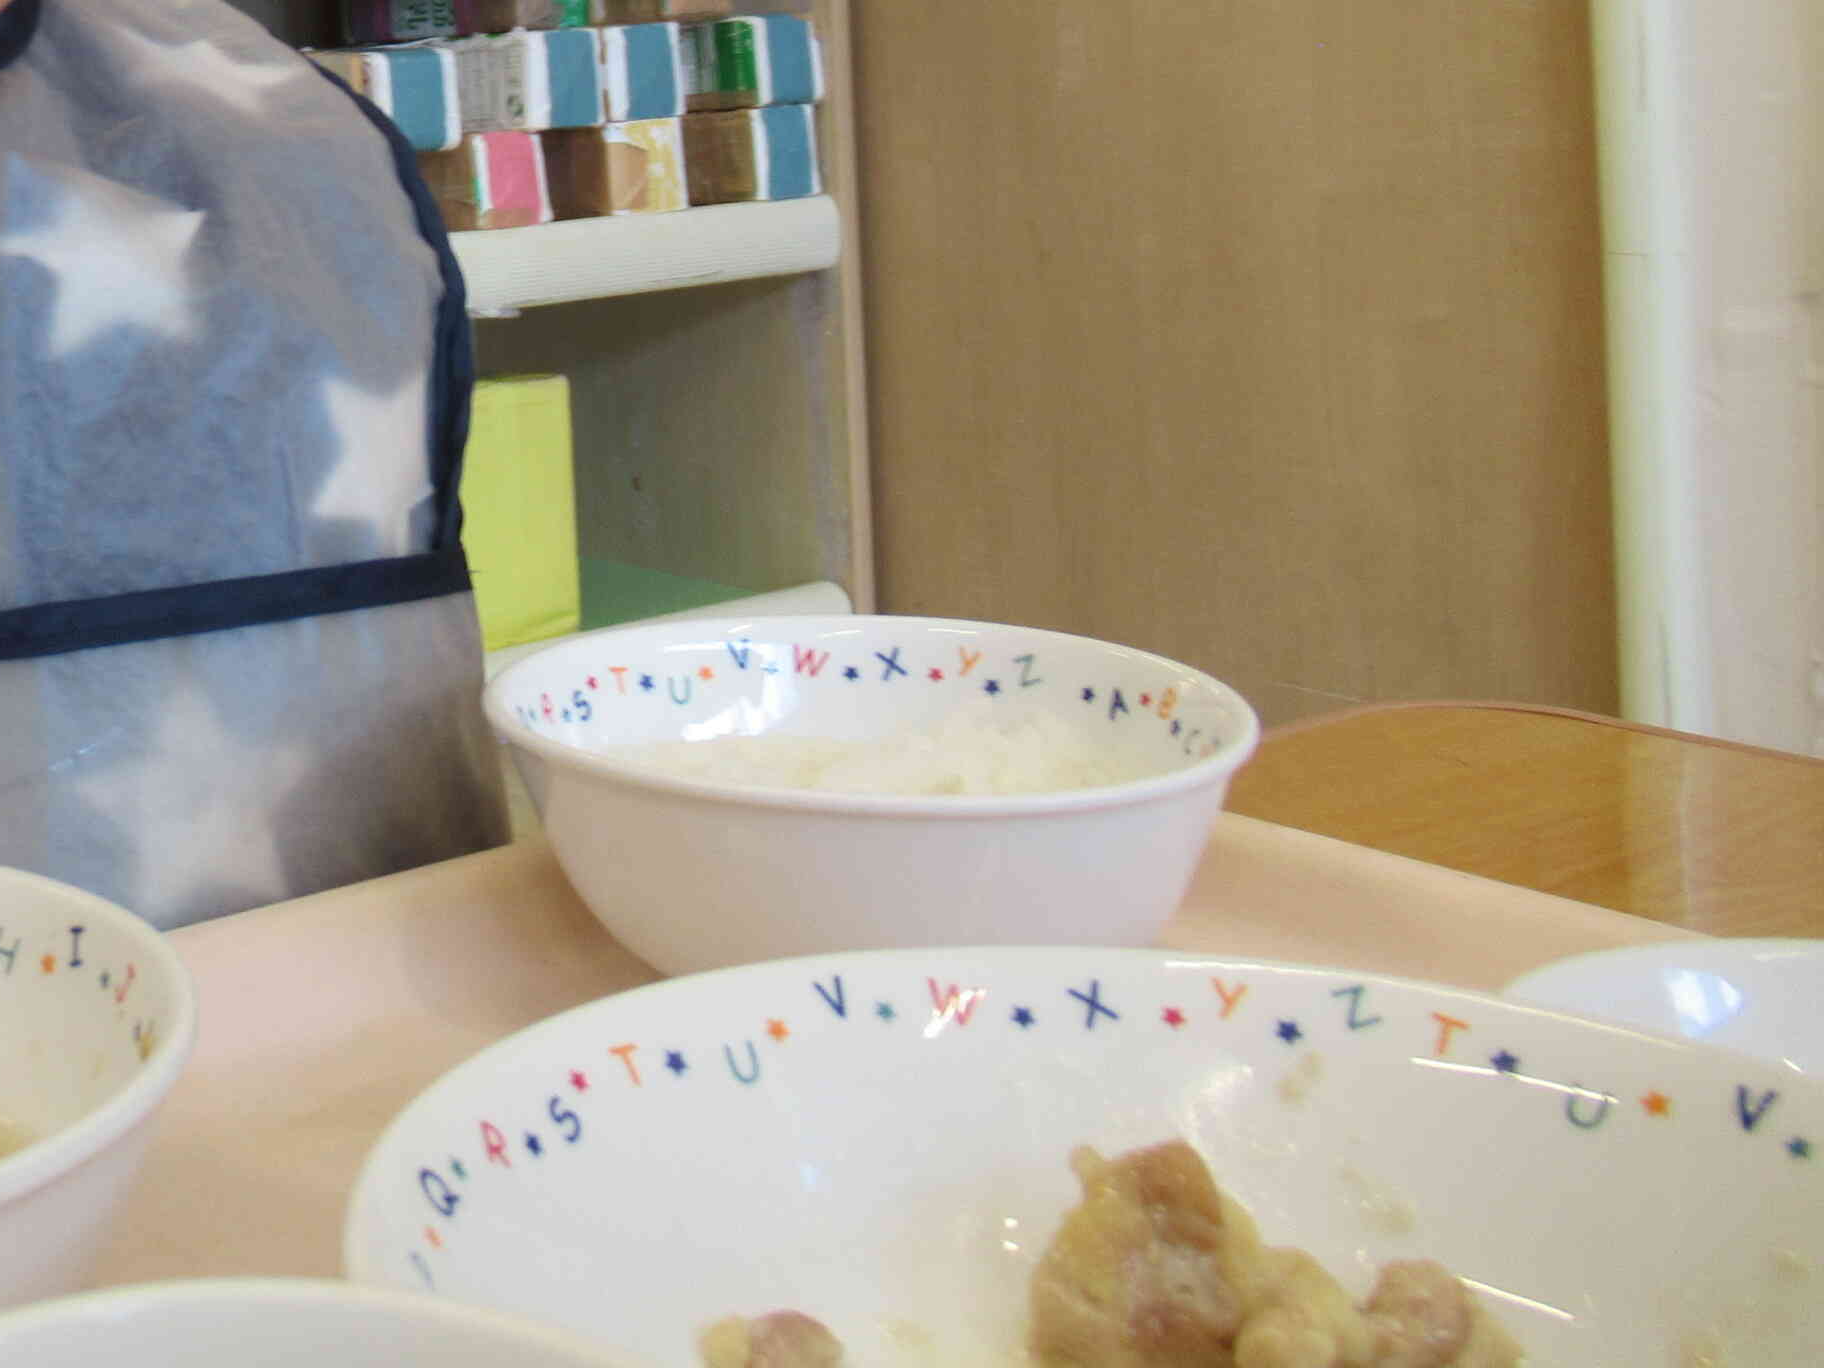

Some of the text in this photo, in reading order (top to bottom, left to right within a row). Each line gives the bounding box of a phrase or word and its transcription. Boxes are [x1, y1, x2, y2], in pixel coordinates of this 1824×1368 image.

[607, 666, 629, 695] T
[666, 676, 692, 705] U
[793, 644, 830, 677] W
[875, 646, 908, 682] X
[959, 646, 982, 677] Y
[1012, 653, 1044, 688] Z
[1108, 688, 1129, 722] A
[418, 974, 1780, 1218] Q R S T U V W X Y Z T U V
